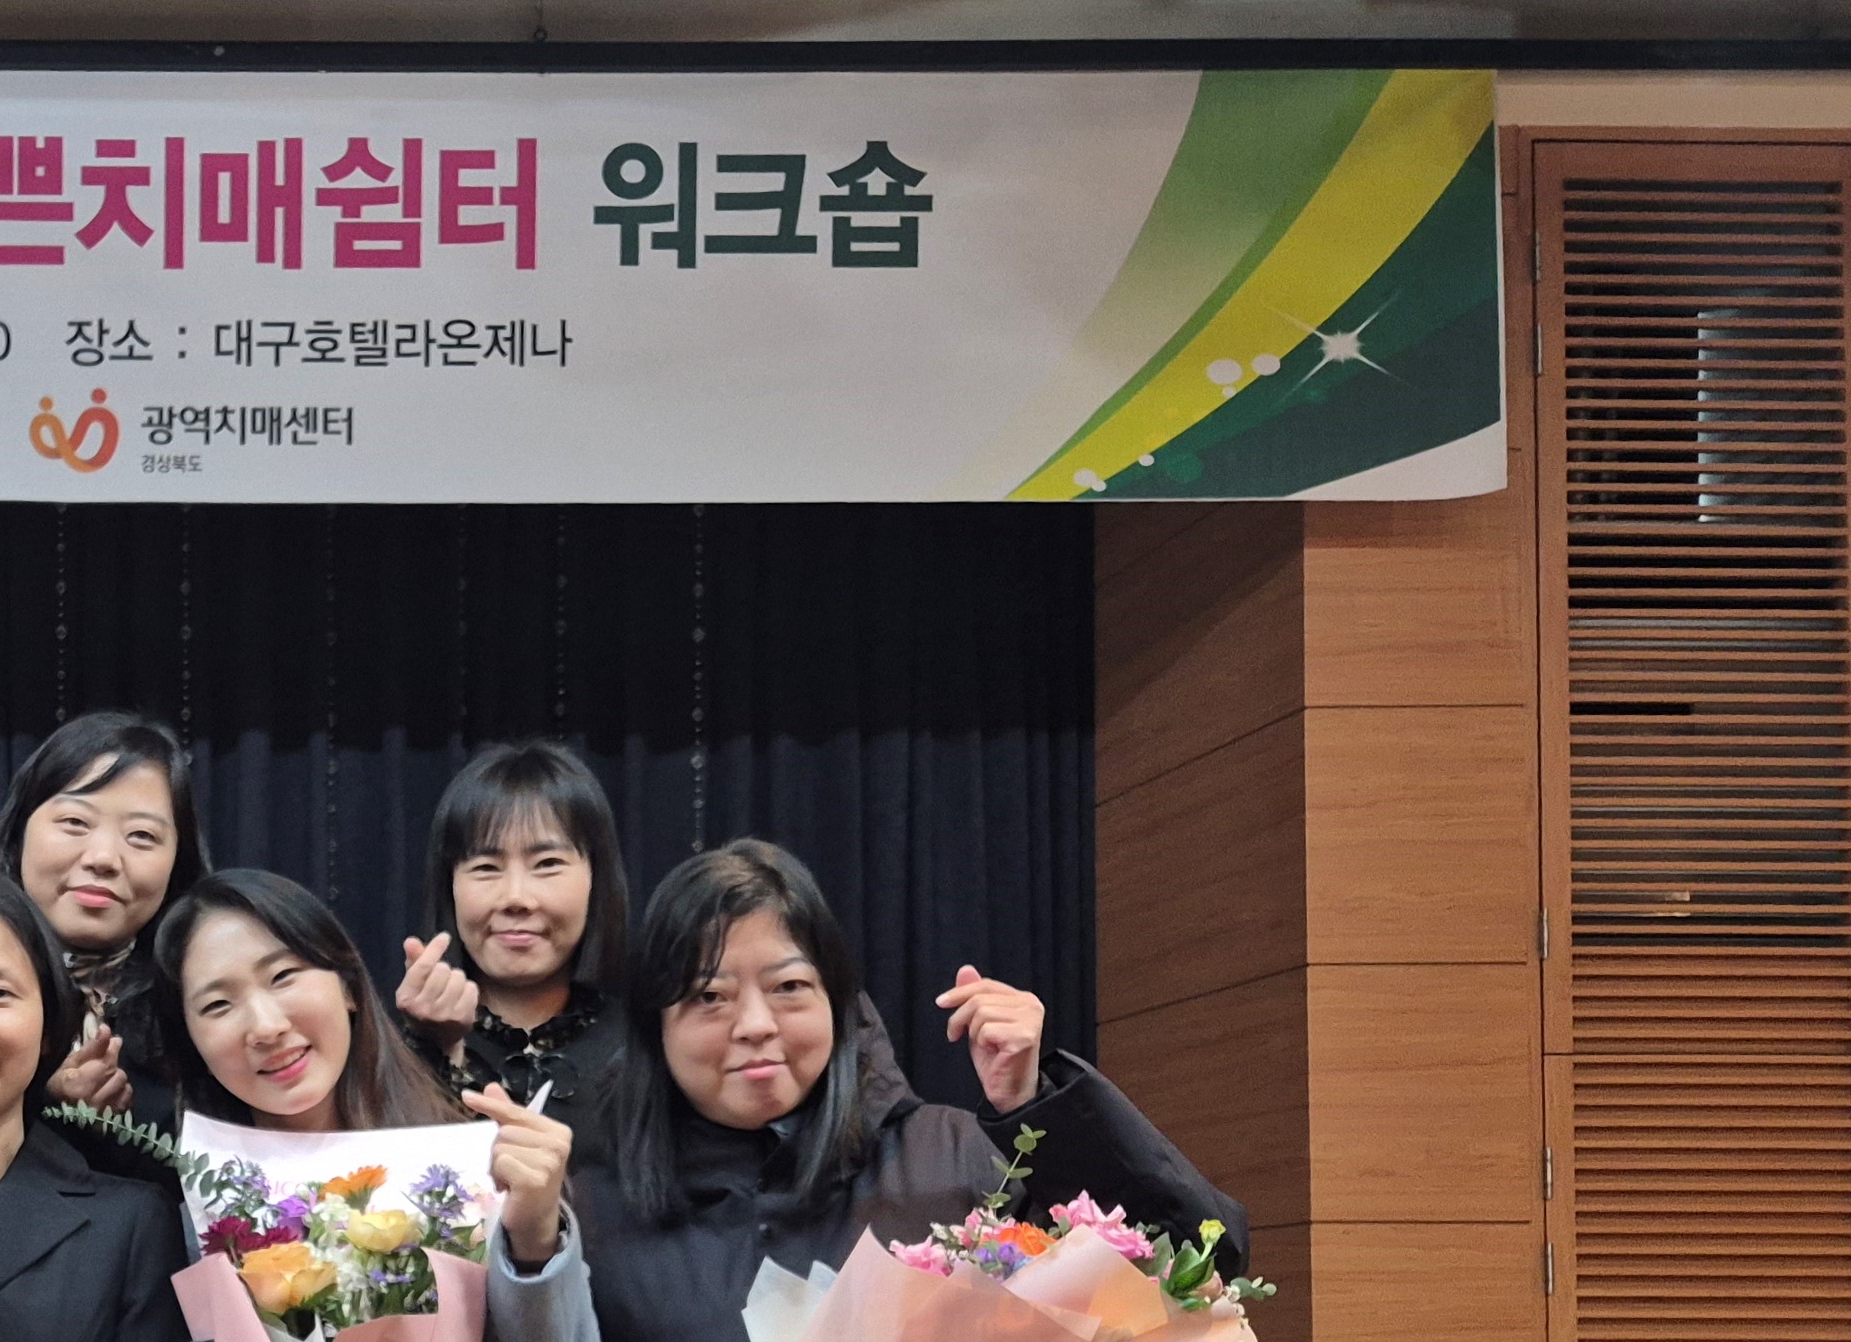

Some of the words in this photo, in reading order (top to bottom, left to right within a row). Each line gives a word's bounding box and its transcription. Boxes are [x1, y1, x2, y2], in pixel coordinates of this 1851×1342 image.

[593, 140, 935, 270] 워크숍
[64, 318, 153, 367] 장소
[214, 319, 574, 369] 대구호텔라온제나
[141, 405, 354, 446] 광역치매센터
[140, 454, 203, 474] 경상북도
